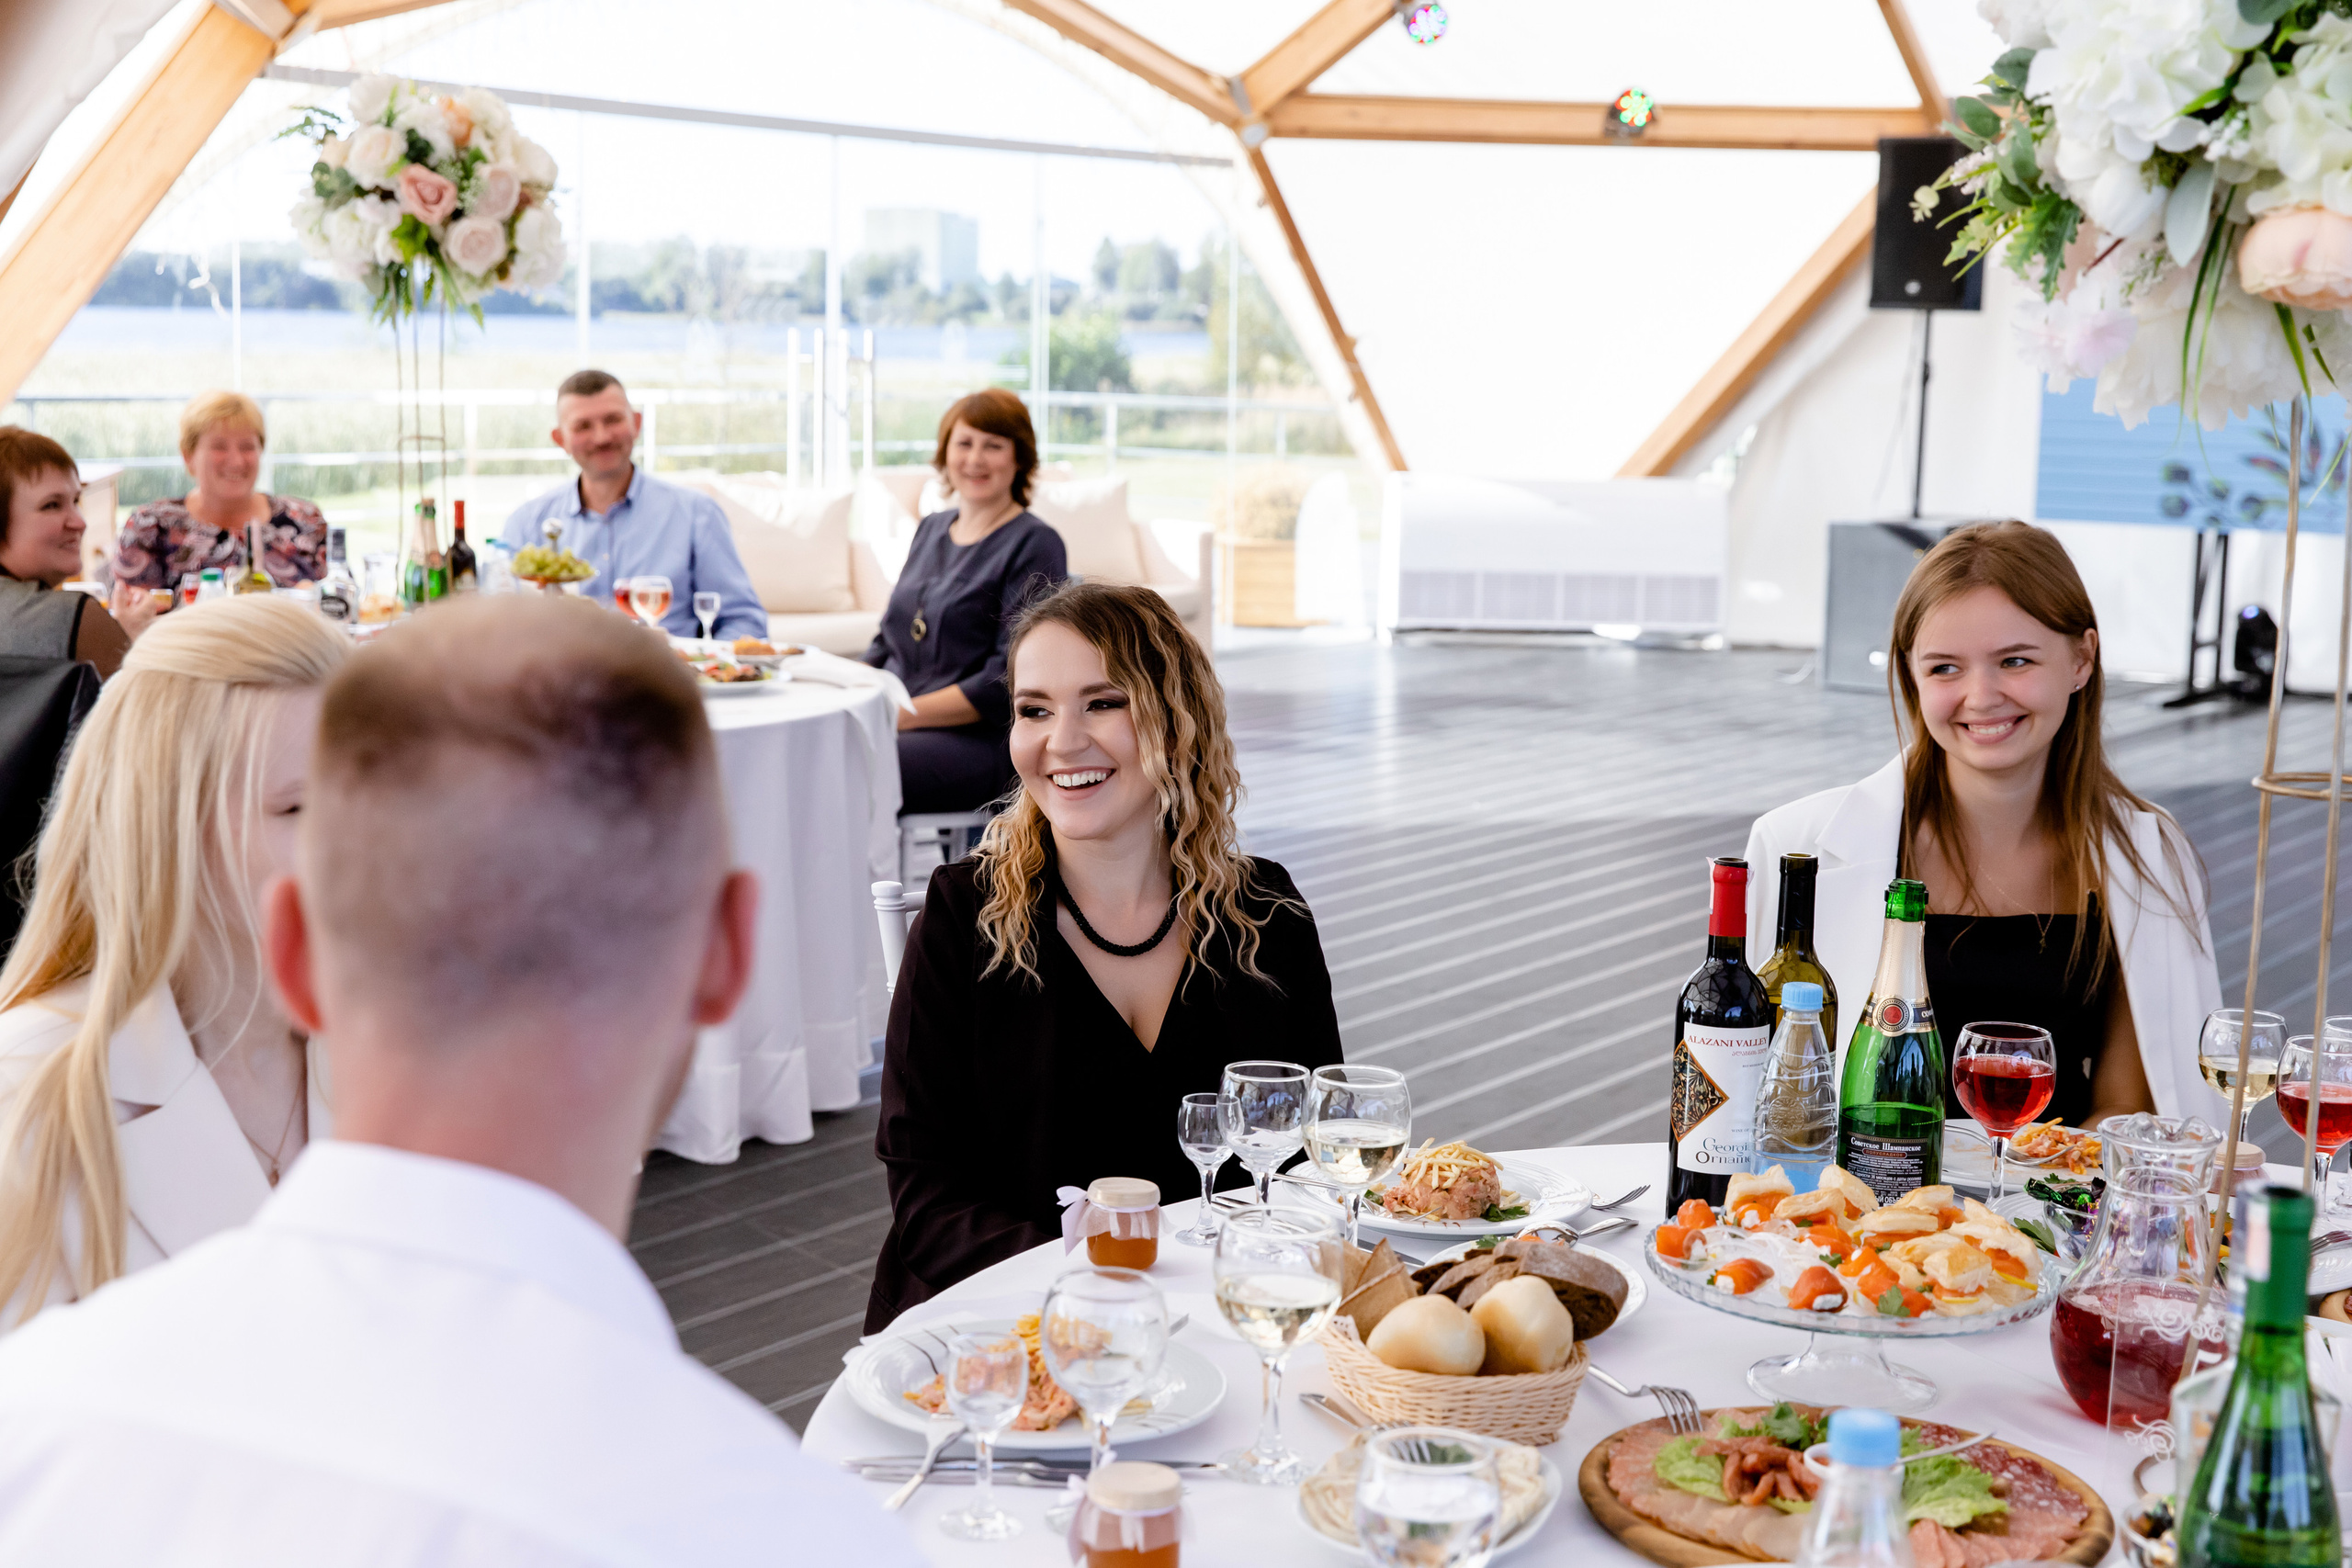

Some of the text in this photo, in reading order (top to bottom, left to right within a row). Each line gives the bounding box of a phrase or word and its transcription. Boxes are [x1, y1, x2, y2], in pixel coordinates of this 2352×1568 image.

[1688, 1035, 1768, 1047] ALAZANI VALLEY
[1850, 1136, 1922, 1152] Советское Шампанское
[1695, 1151, 1751, 1164] Orname
